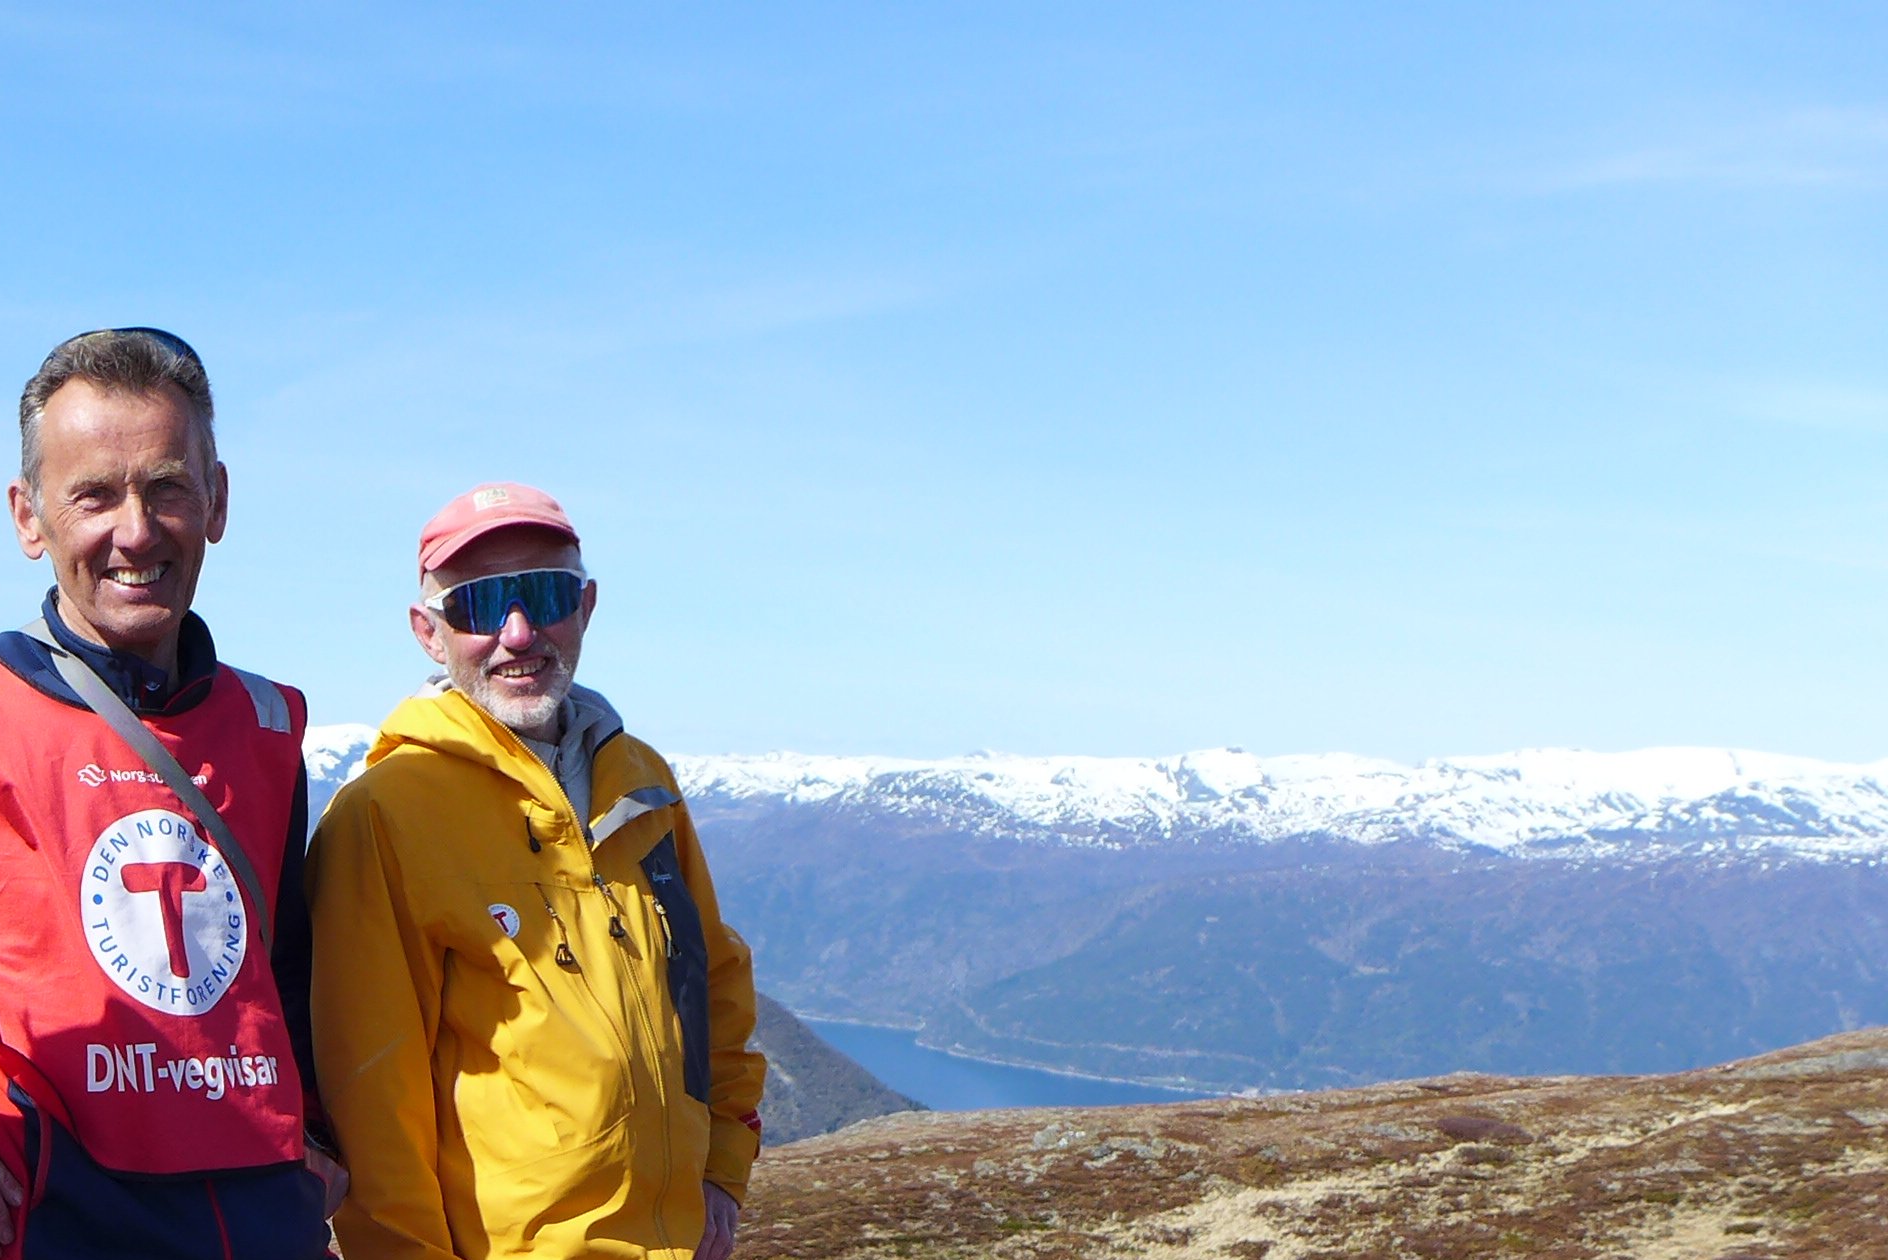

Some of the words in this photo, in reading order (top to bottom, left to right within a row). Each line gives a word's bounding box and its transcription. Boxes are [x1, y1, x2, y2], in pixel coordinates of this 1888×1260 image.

[92, 832, 129, 883] DEN
[92, 914, 241, 1006] TURISTFORENING
[86, 1043, 278, 1101] DNT-vegvisar
